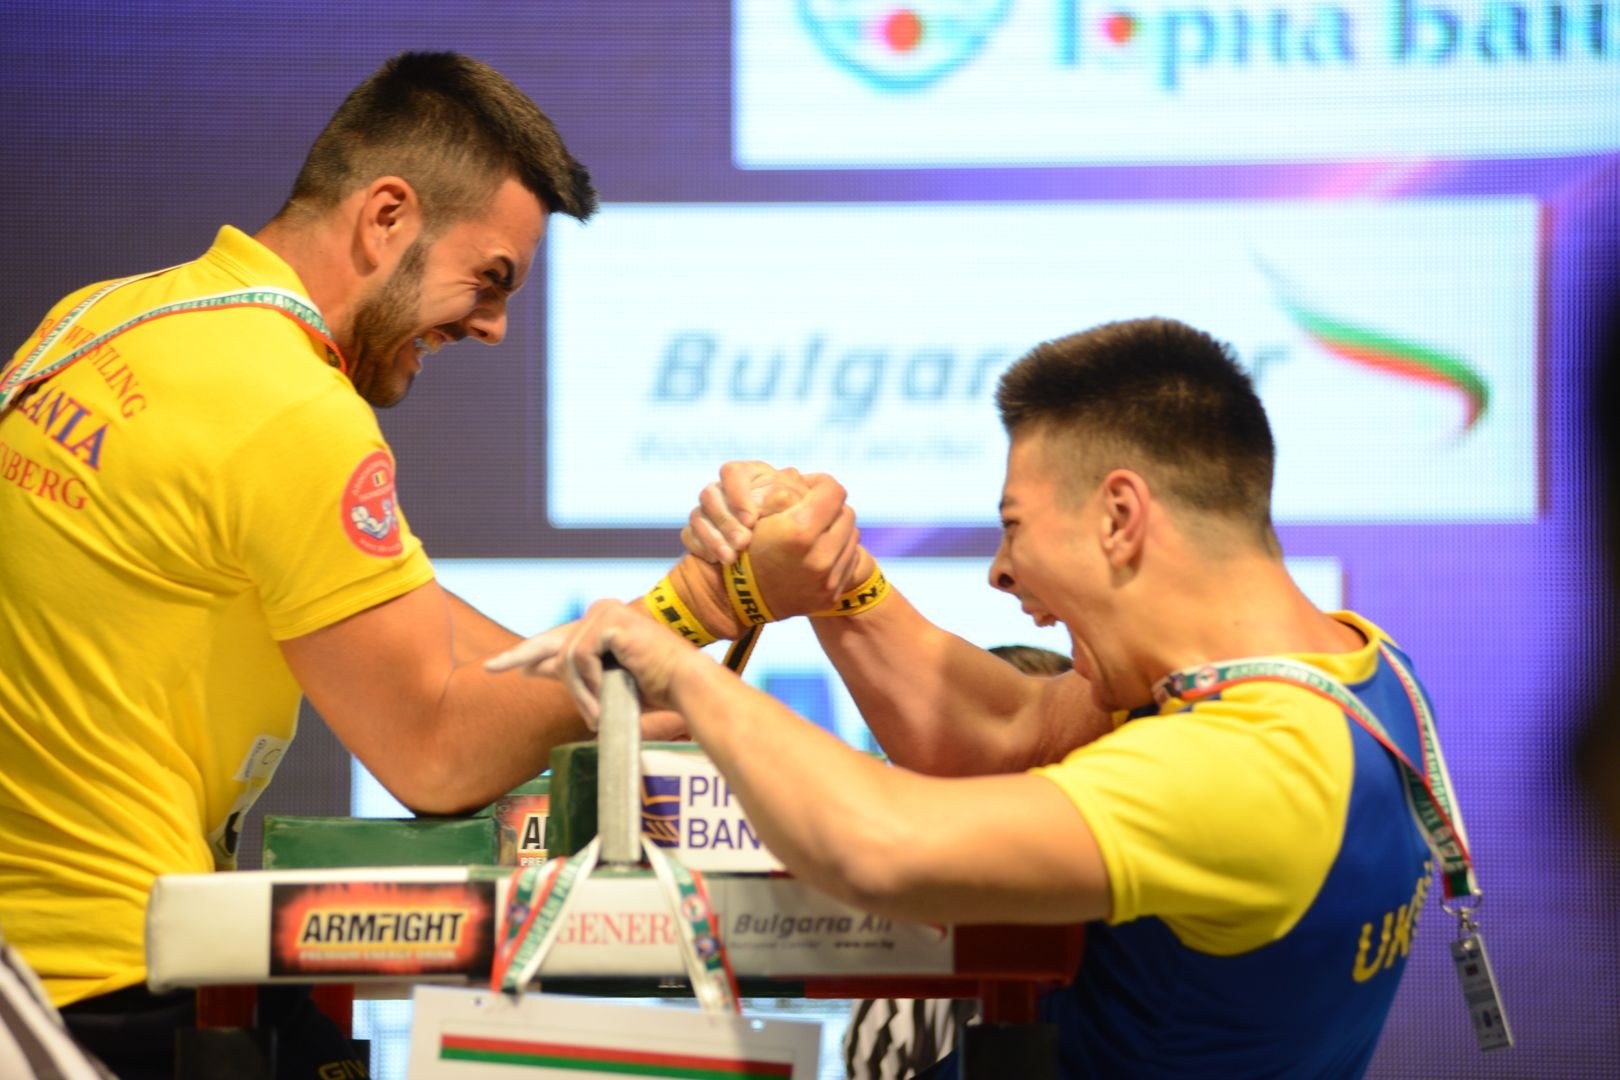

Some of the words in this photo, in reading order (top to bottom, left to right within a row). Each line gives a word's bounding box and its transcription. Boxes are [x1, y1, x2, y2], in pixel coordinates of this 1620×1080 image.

[650, 331, 1007, 427] Bulgar
[18, 384, 110, 472] ANIA
[687, 818, 761, 849] BAN
[303, 911, 465, 943] ARMFIGHT
[733, 913, 853, 939] Bulgaria
